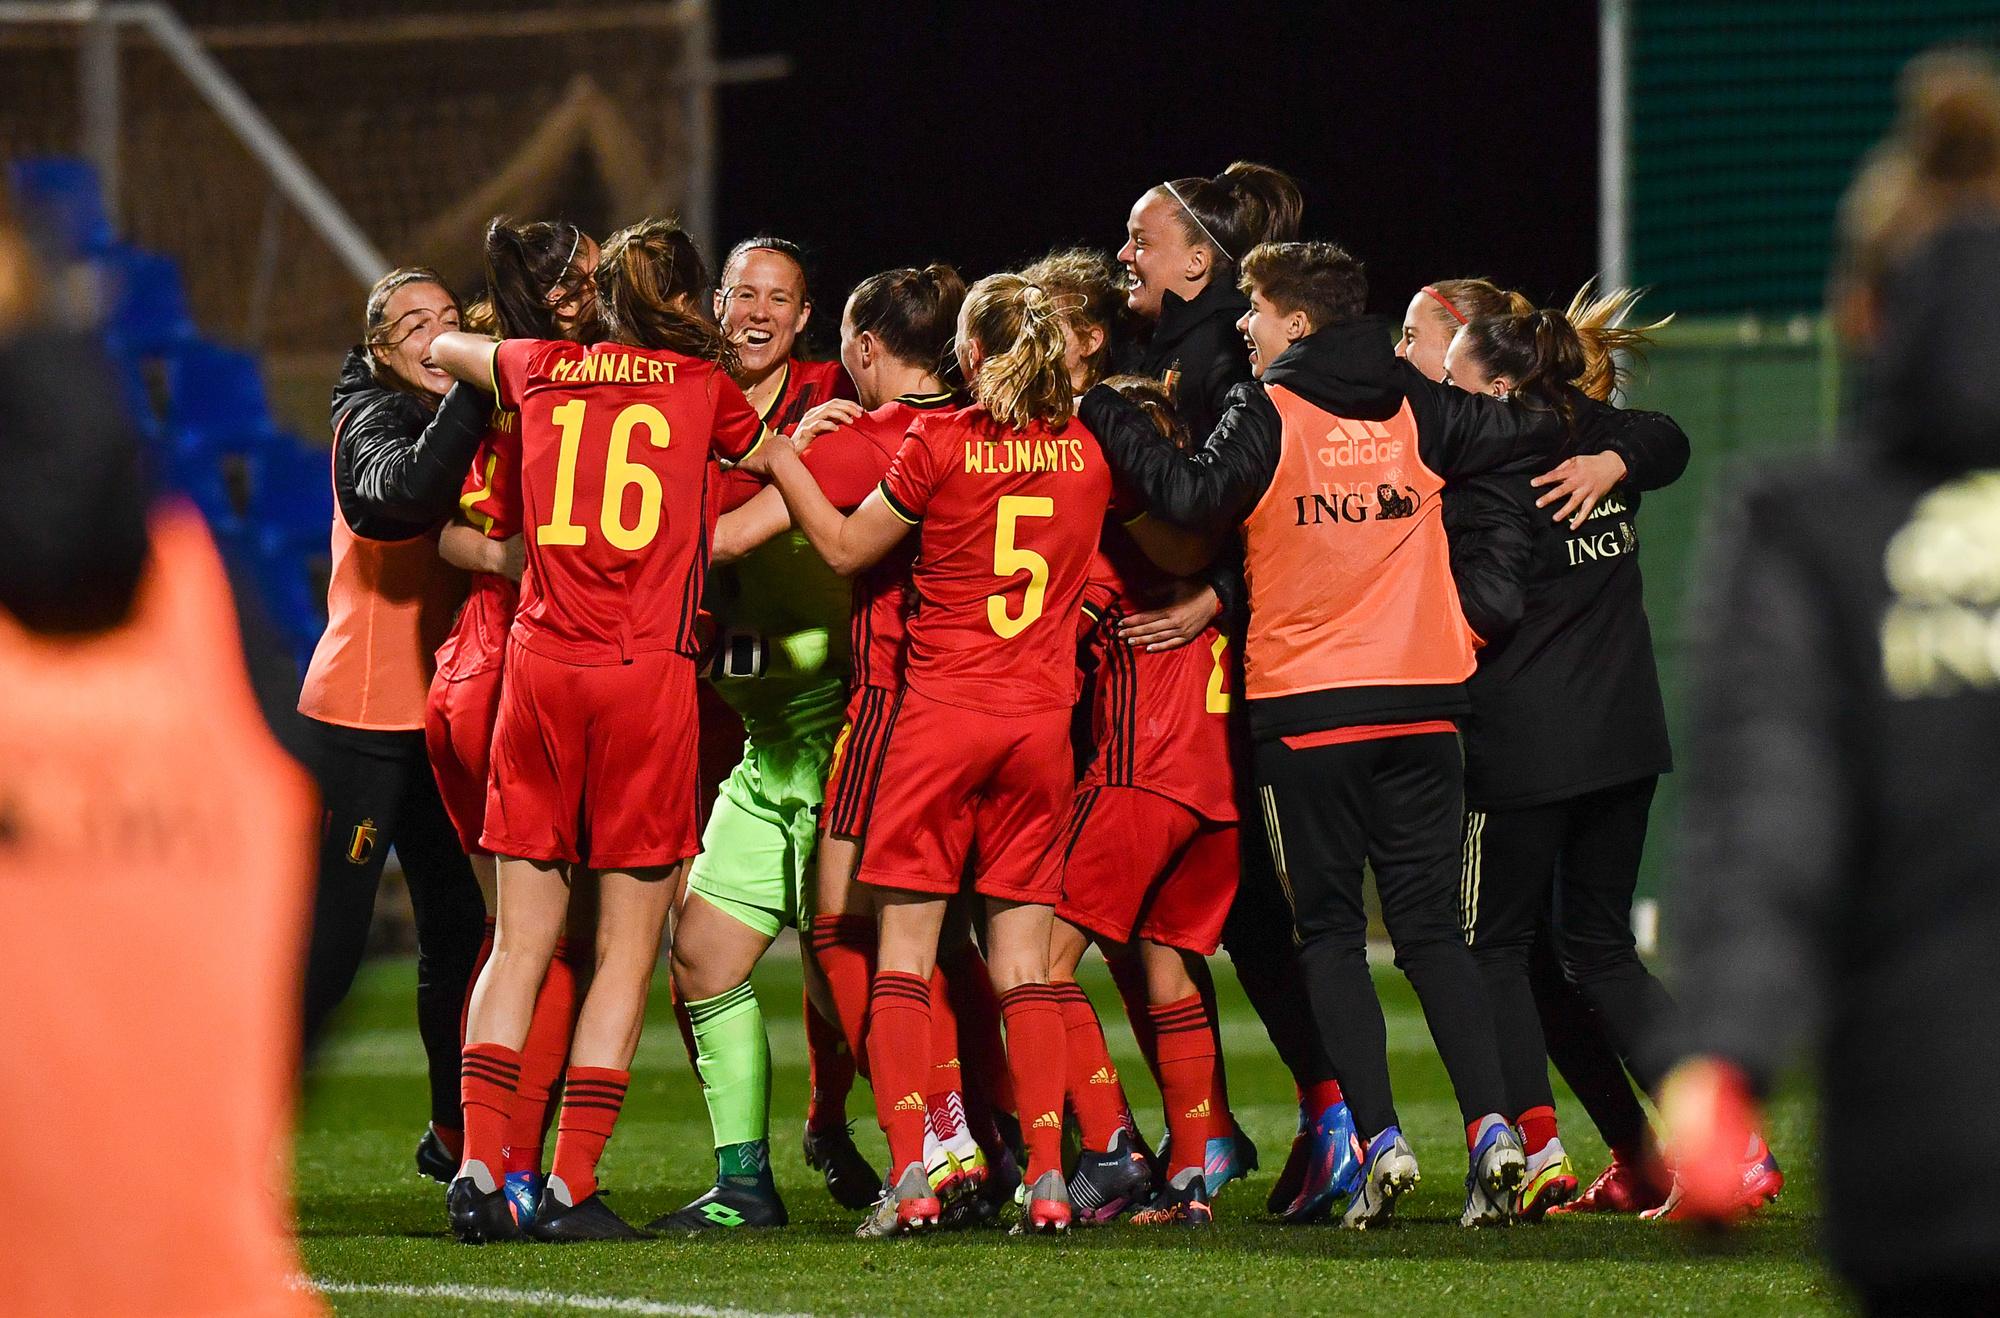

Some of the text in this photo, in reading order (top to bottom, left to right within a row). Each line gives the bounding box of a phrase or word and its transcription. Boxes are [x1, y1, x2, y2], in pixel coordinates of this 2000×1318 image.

[551, 353, 677, 384] MINNAERT
[964, 439, 1085, 474] WIJNANTS
[1317, 437, 1404, 468] adidas
[537, 399, 671, 551] 16
[1294, 493, 1368, 526] ING
[1565, 531, 1621, 566] ING
[987, 495, 1054, 639] 5
[1184, 1110, 1210, 1119] adida
